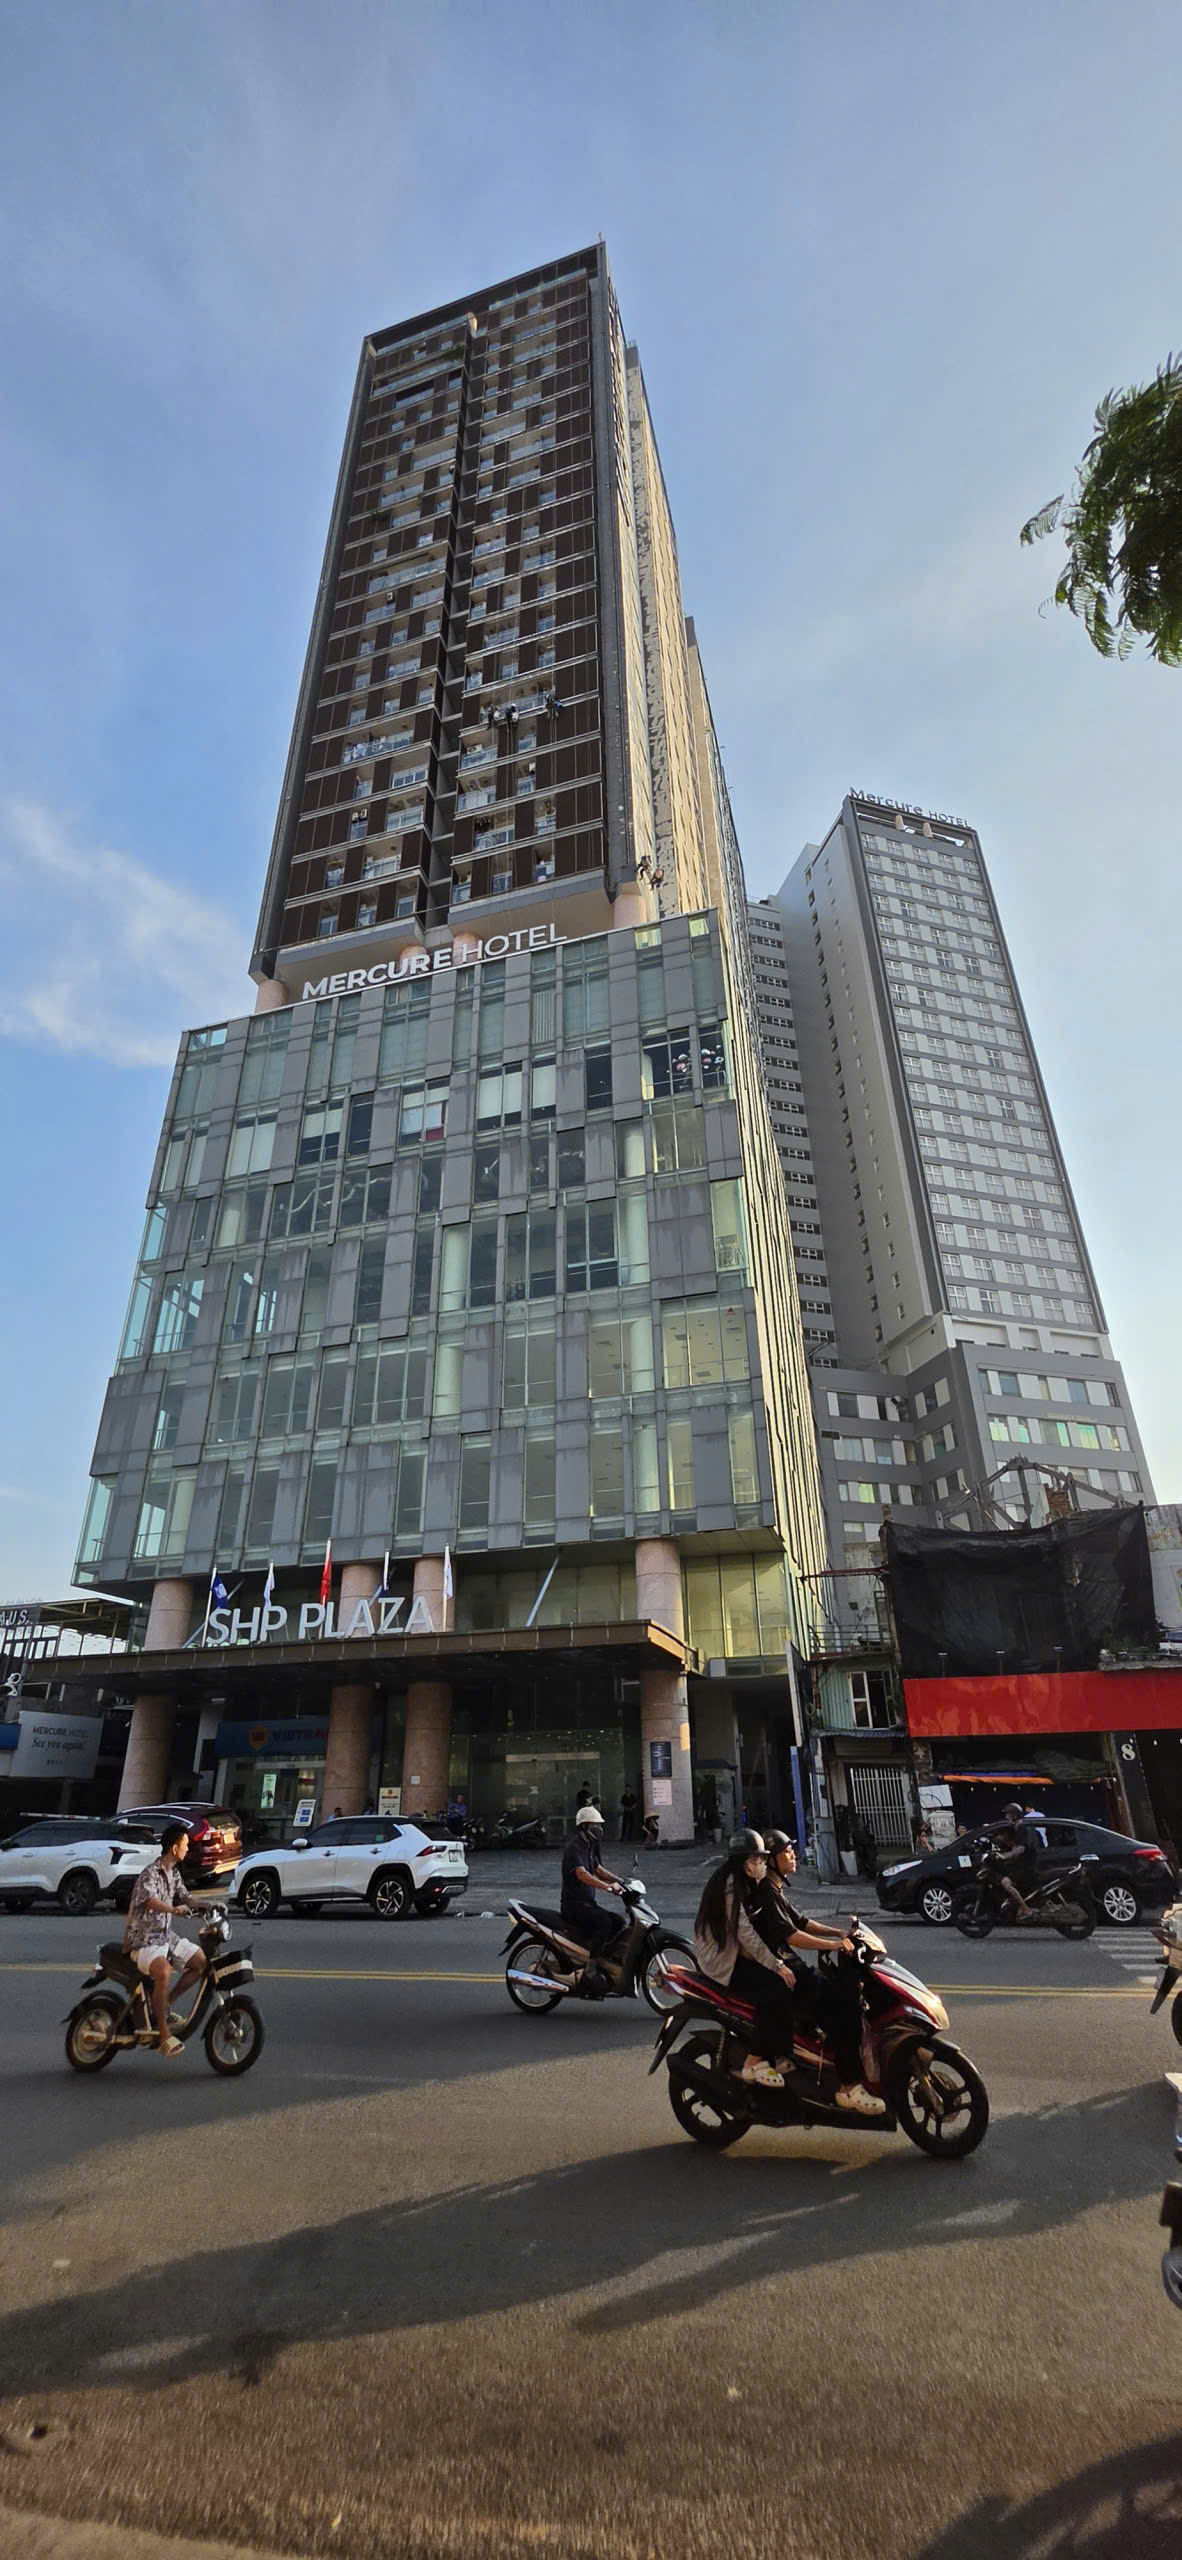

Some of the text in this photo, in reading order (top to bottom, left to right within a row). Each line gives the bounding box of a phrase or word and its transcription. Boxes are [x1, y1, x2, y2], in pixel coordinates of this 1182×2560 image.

[850, 786, 972, 829] Mercure HOTEL
[302, 923, 567, 1000] MERCURE HOTEL
[206, 1596, 434, 1645] SHP PLAZA
[32, 1737, 45, 1748] See
[46, 1741, 61, 1752] you
[33, 1726, 67, 1736] MERCURE
